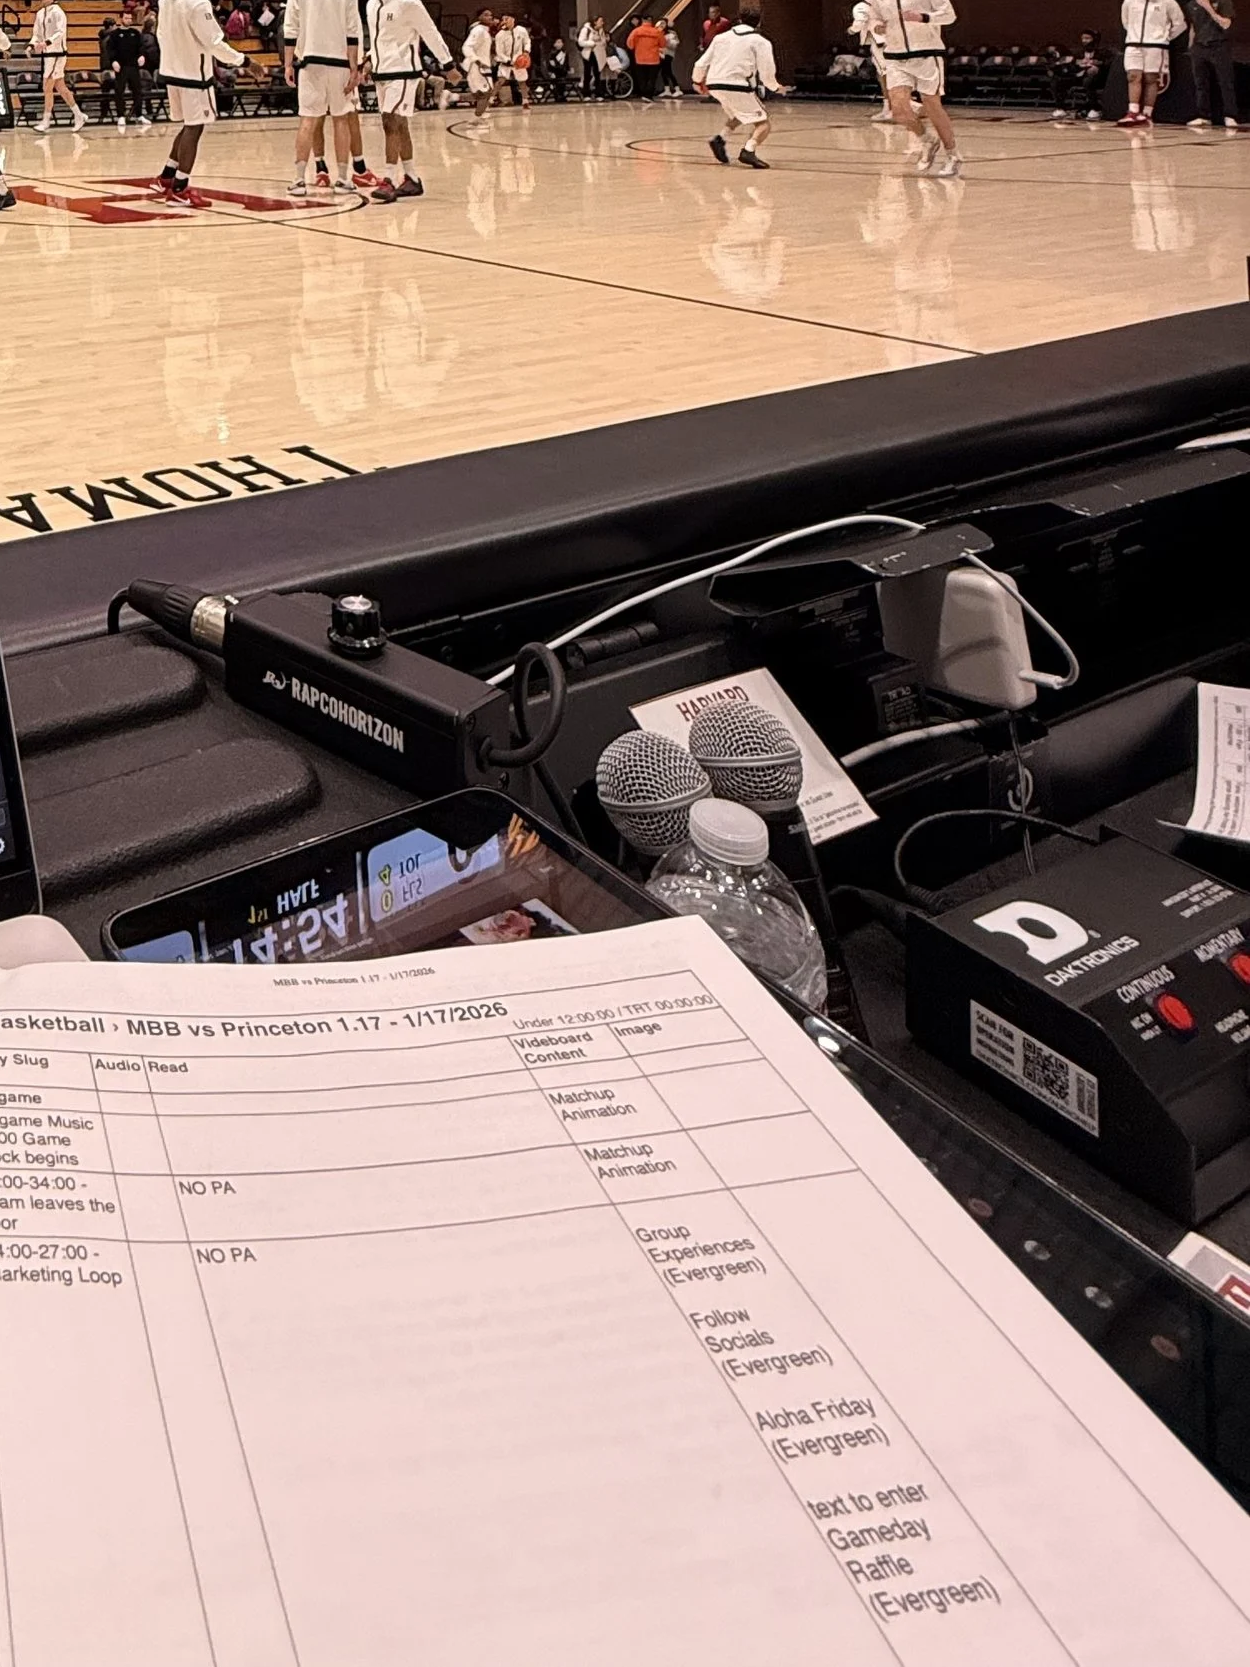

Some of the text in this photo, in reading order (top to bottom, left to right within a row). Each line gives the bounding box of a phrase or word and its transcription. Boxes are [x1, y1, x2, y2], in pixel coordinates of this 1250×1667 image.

[291, 677, 405, 753] RAPCOHORIZON
[1044, 935, 1140, 987] DAKTRONICS
[1193, 926, 1246, 963] MOMENTARY
[1116, 964, 1176, 1004] CONTINUOUS
[127, 1019, 181, 1037] MBB
[188, 1024, 216, 1038] vs
[222, 1017, 331, 1038] Princeton
[337, 1014, 381, 1034] 1.17
[402, 1001, 509, 1031] 1/17/2026
[12, 1052, 49, 1070] Slug
[94, 1057, 142, 1073] Audio
[148, 1059, 189, 1074] Read
[614, 1019, 662, 1038] Image
[514, 1029, 594, 1052] Videboard
[524, 1045, 588, 1066] Content
[22, 1132, 71, 1147] Game
[560, 1100, 637, 1123] Animation
[48, 1115, 95, 1131] Music
[549, 1086, 616, 1108] Matchup
[24, 1150, 79, 1168] begins
[29, 1194, 85, 1213] leaves
[88, 1197, 116, 1215] the
[178, 1180, 208, 1196] NO
[211, 1180, 237, 1196] PA
[635, 1222, 691, 1243] Group
[647, 1236, 756, 1264] Experiences
[78, 1267, 123, 1288] Loop
[661, 1256, 768, 1288] (Evergreen)
[689, 1306, 751, 1330] Follow
[704, 1328, 775, 1354] Socials
[721, 1344, 834, 1381] (Evergreen)
[755, 1394, 877, 1432] Aloha Friday
[770, 1422, 891, 1464] (Evergreen)
[807, 1482, 930, 1521] text to enter
[826, 1514, 932, 1552] Gameday
[845, 1552, 914, 1584] Raffle
[869, 1574, 1002, 1623] (Evergreen)
